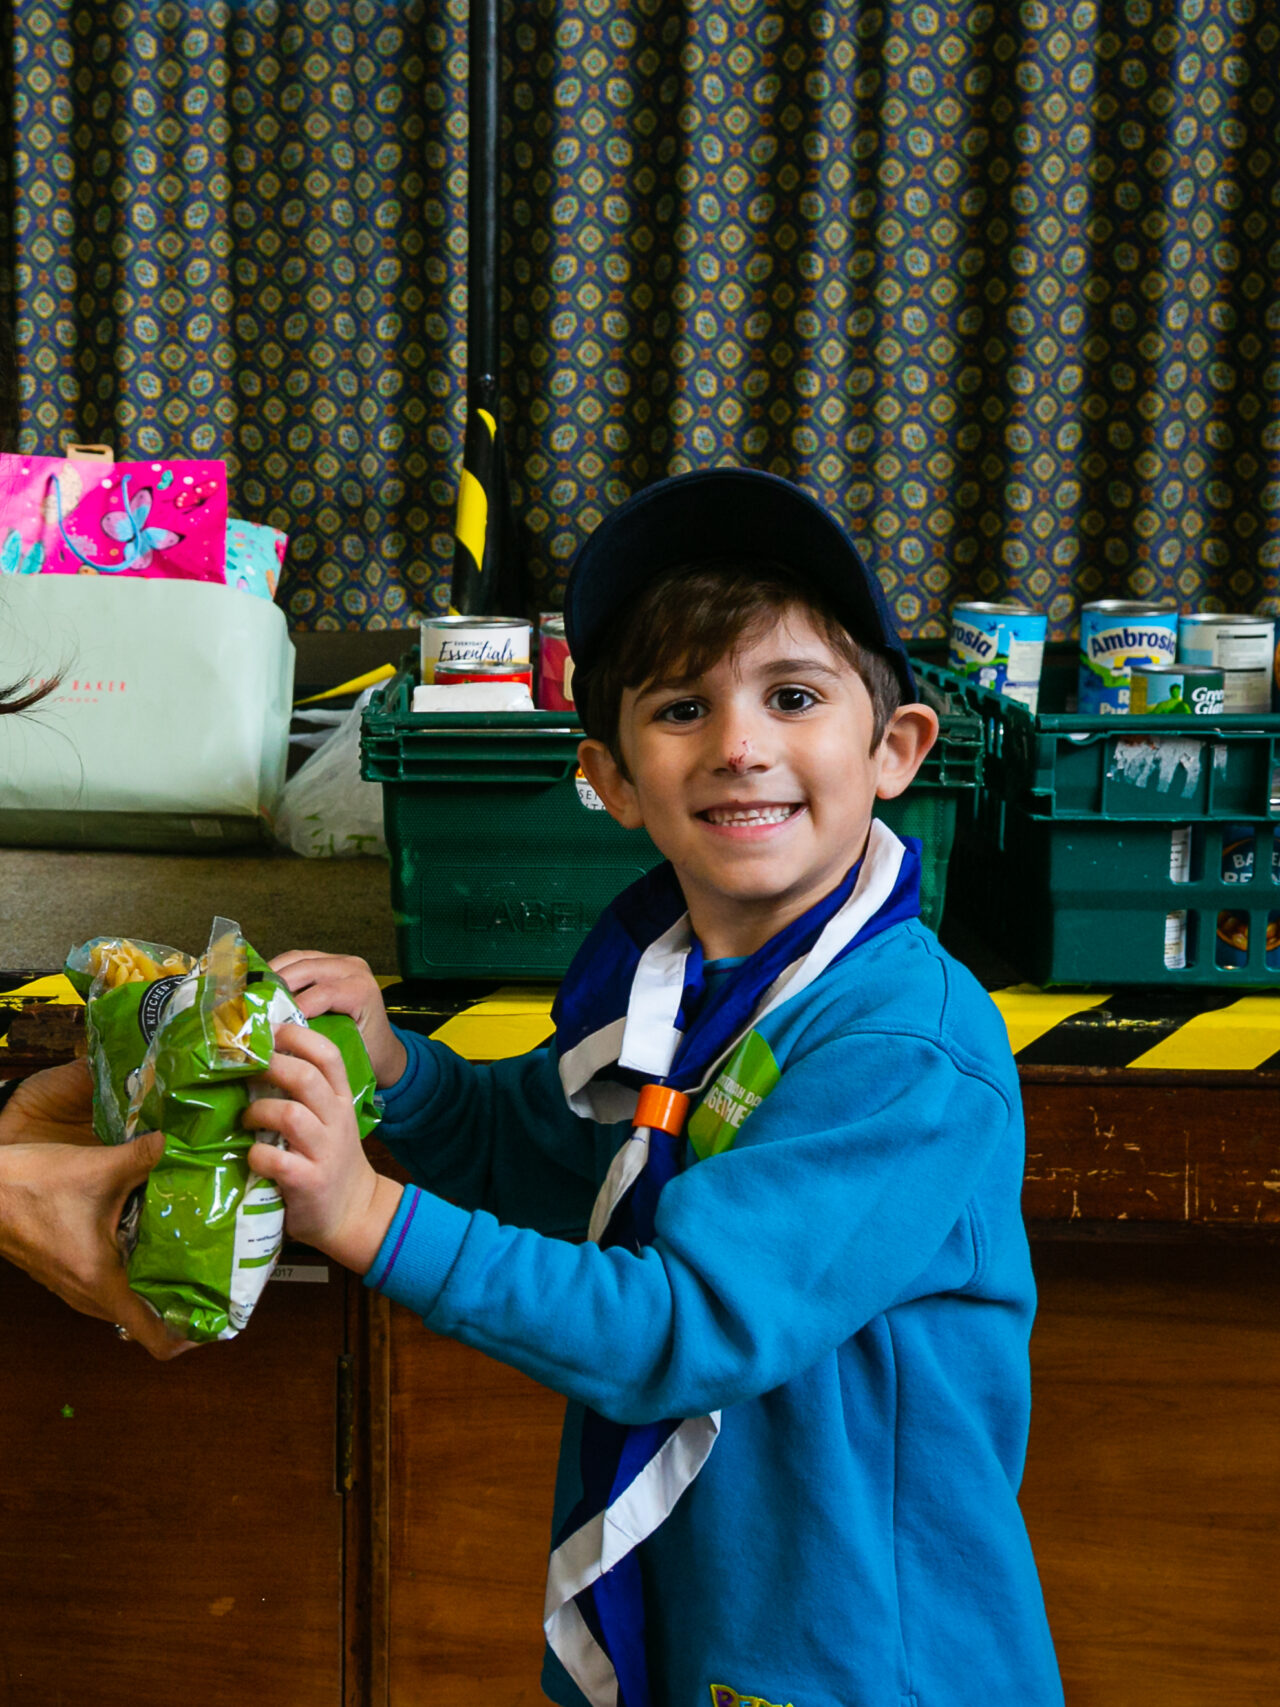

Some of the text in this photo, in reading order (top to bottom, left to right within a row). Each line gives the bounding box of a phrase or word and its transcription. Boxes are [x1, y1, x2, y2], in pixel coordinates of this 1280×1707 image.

[438, 638, 514, 662] Essentials
[72, 680, 126, 692] BAKER
[147, 984, 170, 1025] KITCHEN
[744, 1091, 762, 1107] DA
